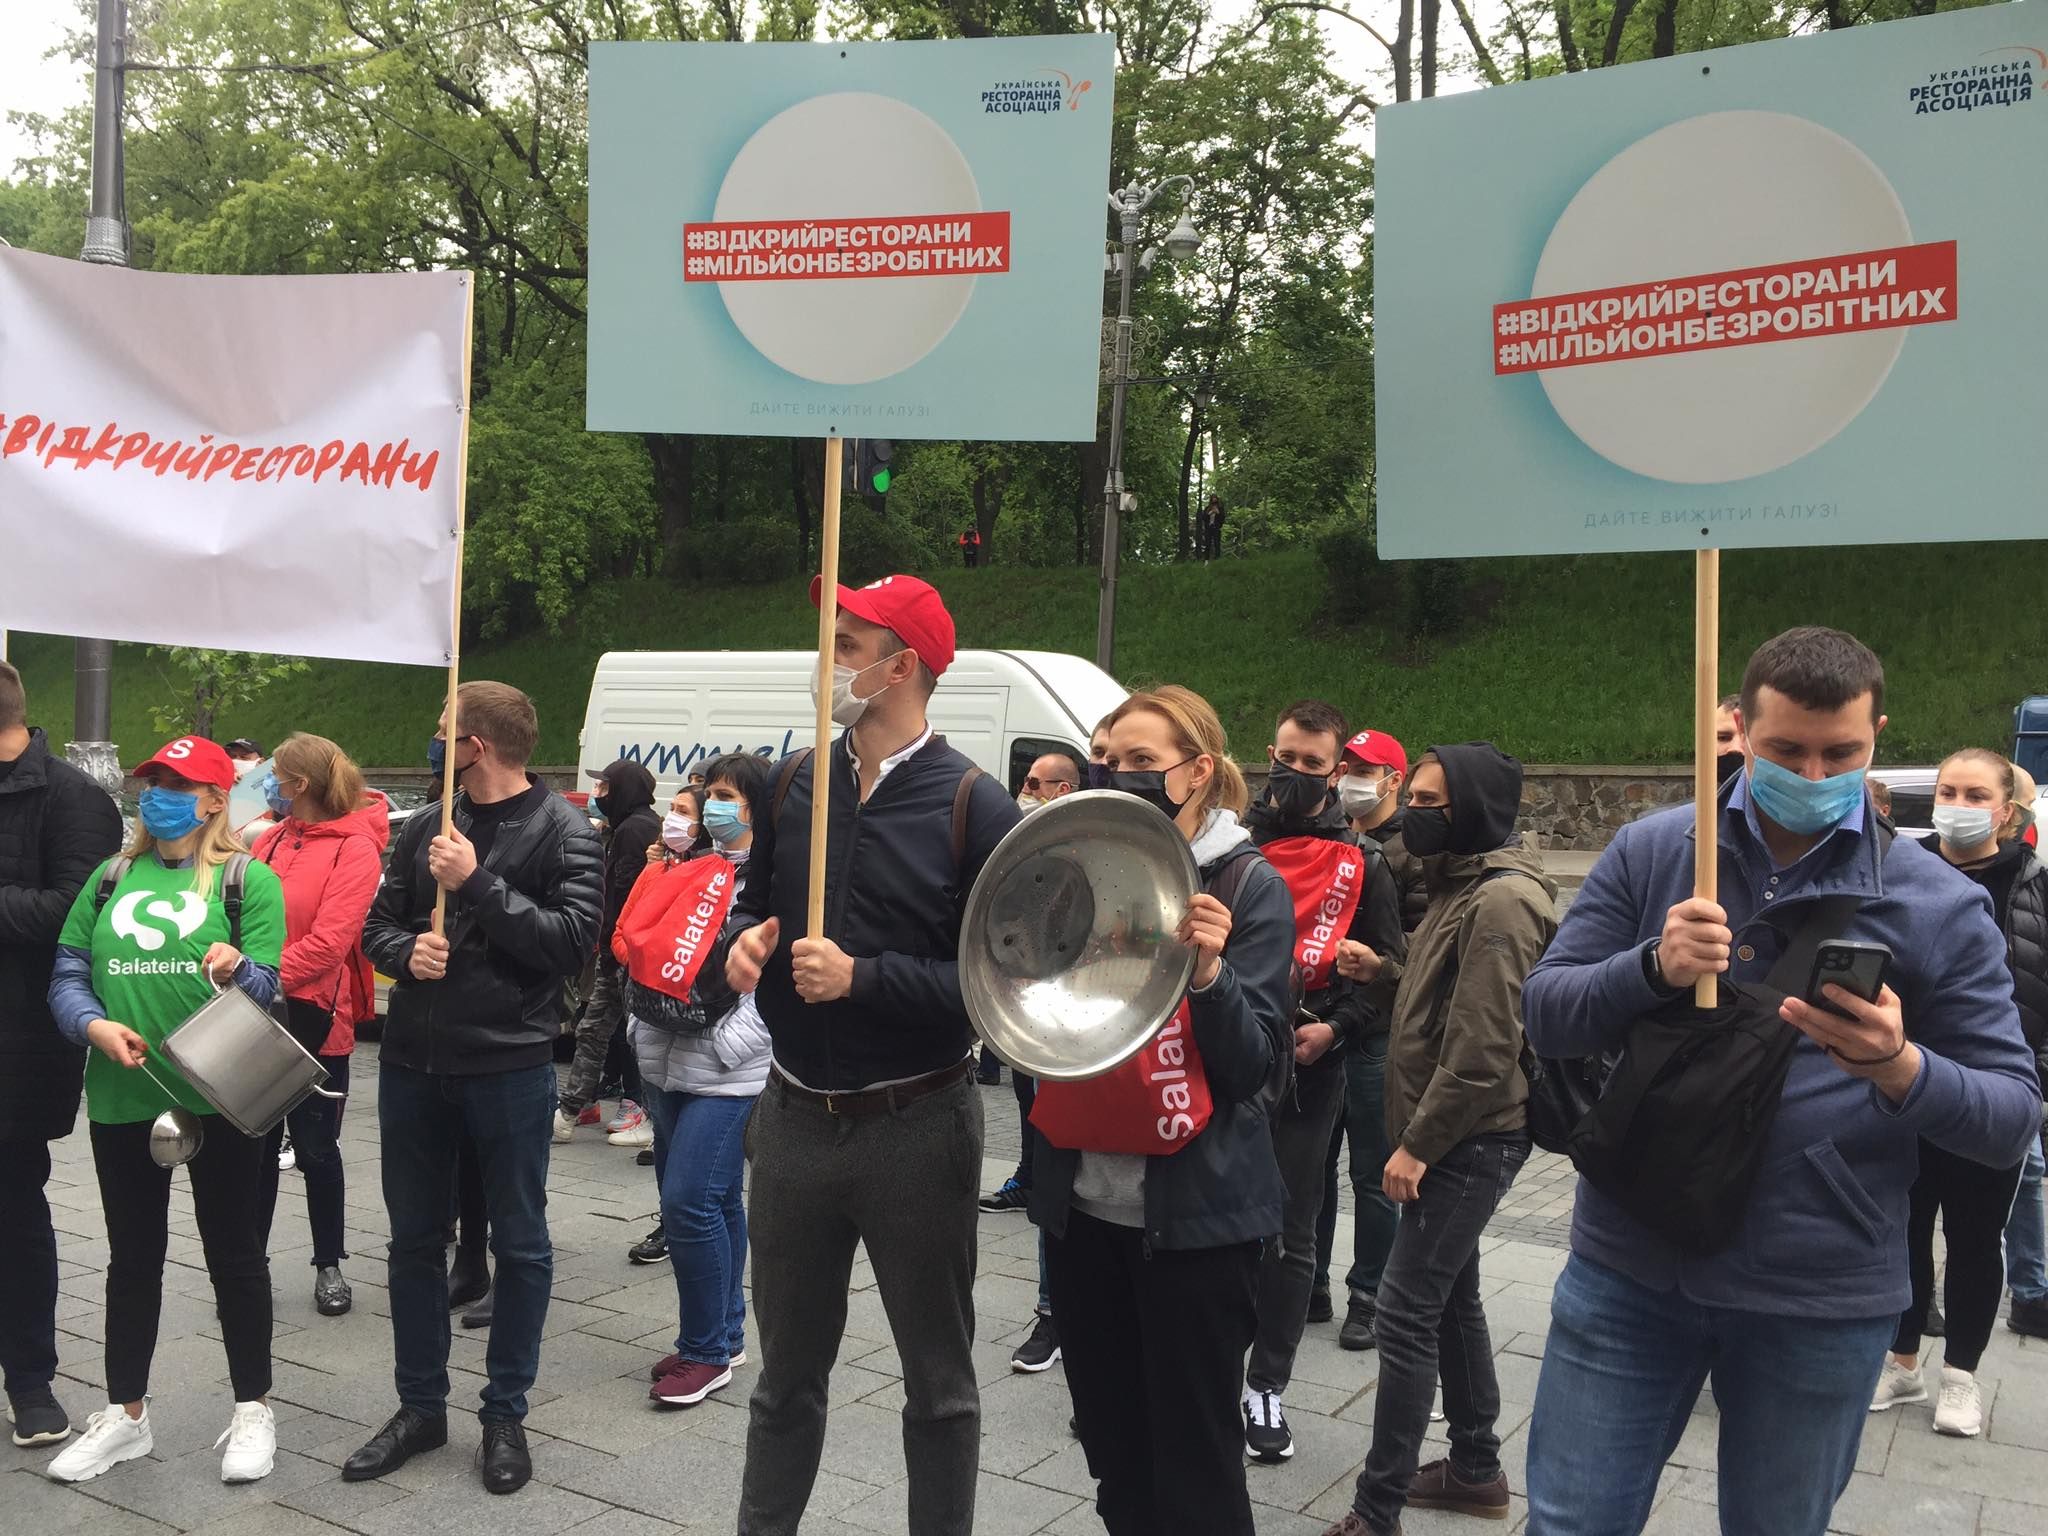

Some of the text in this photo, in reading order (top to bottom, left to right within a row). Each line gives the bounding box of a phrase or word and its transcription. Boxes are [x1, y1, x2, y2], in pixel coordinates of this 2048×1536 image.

[1929, 60, 2032, 82] УКРАЇНСЬКА
[981, 90, 1061, 102] РЕСТОРАННА
[994, 80, 1061, 90] УКРАЇНСЬКА
[1910, 72, 2033, 101] РЕСТОРАННА
[985, 101, 1061, 115] АСОЦІАЦІЯ
[1915, 87, 2032, 114] АСОЦІАЦІЯ
[687, 222, 972, 253] #ВІДКРИЙРЕСТОРАНИ
[687, 246, 1003, 276] #МІЛЬЙОНБЕЗРОБІТНИХ
[1498, 258, 1897, 336] #ВІДКРИЙРЕСТОРАНИ
[1499, 287, 1947, 366] #МІЛЬЙОНБЕЗРОБІТНИХ
[0, 413, 439, 491] ВІДКРИЙРЕСТОРАНИ
[1584, 510, 1650, 529] ДАЙТЕ
[1661, 507, 1752, 524] ВИЖИТИ
[166, 739, 195, 759] S
[1352, 732, 1370, 745] S
[661, 872, 728, 983] Salateira
[108, 957, 198, 976] Salateira
